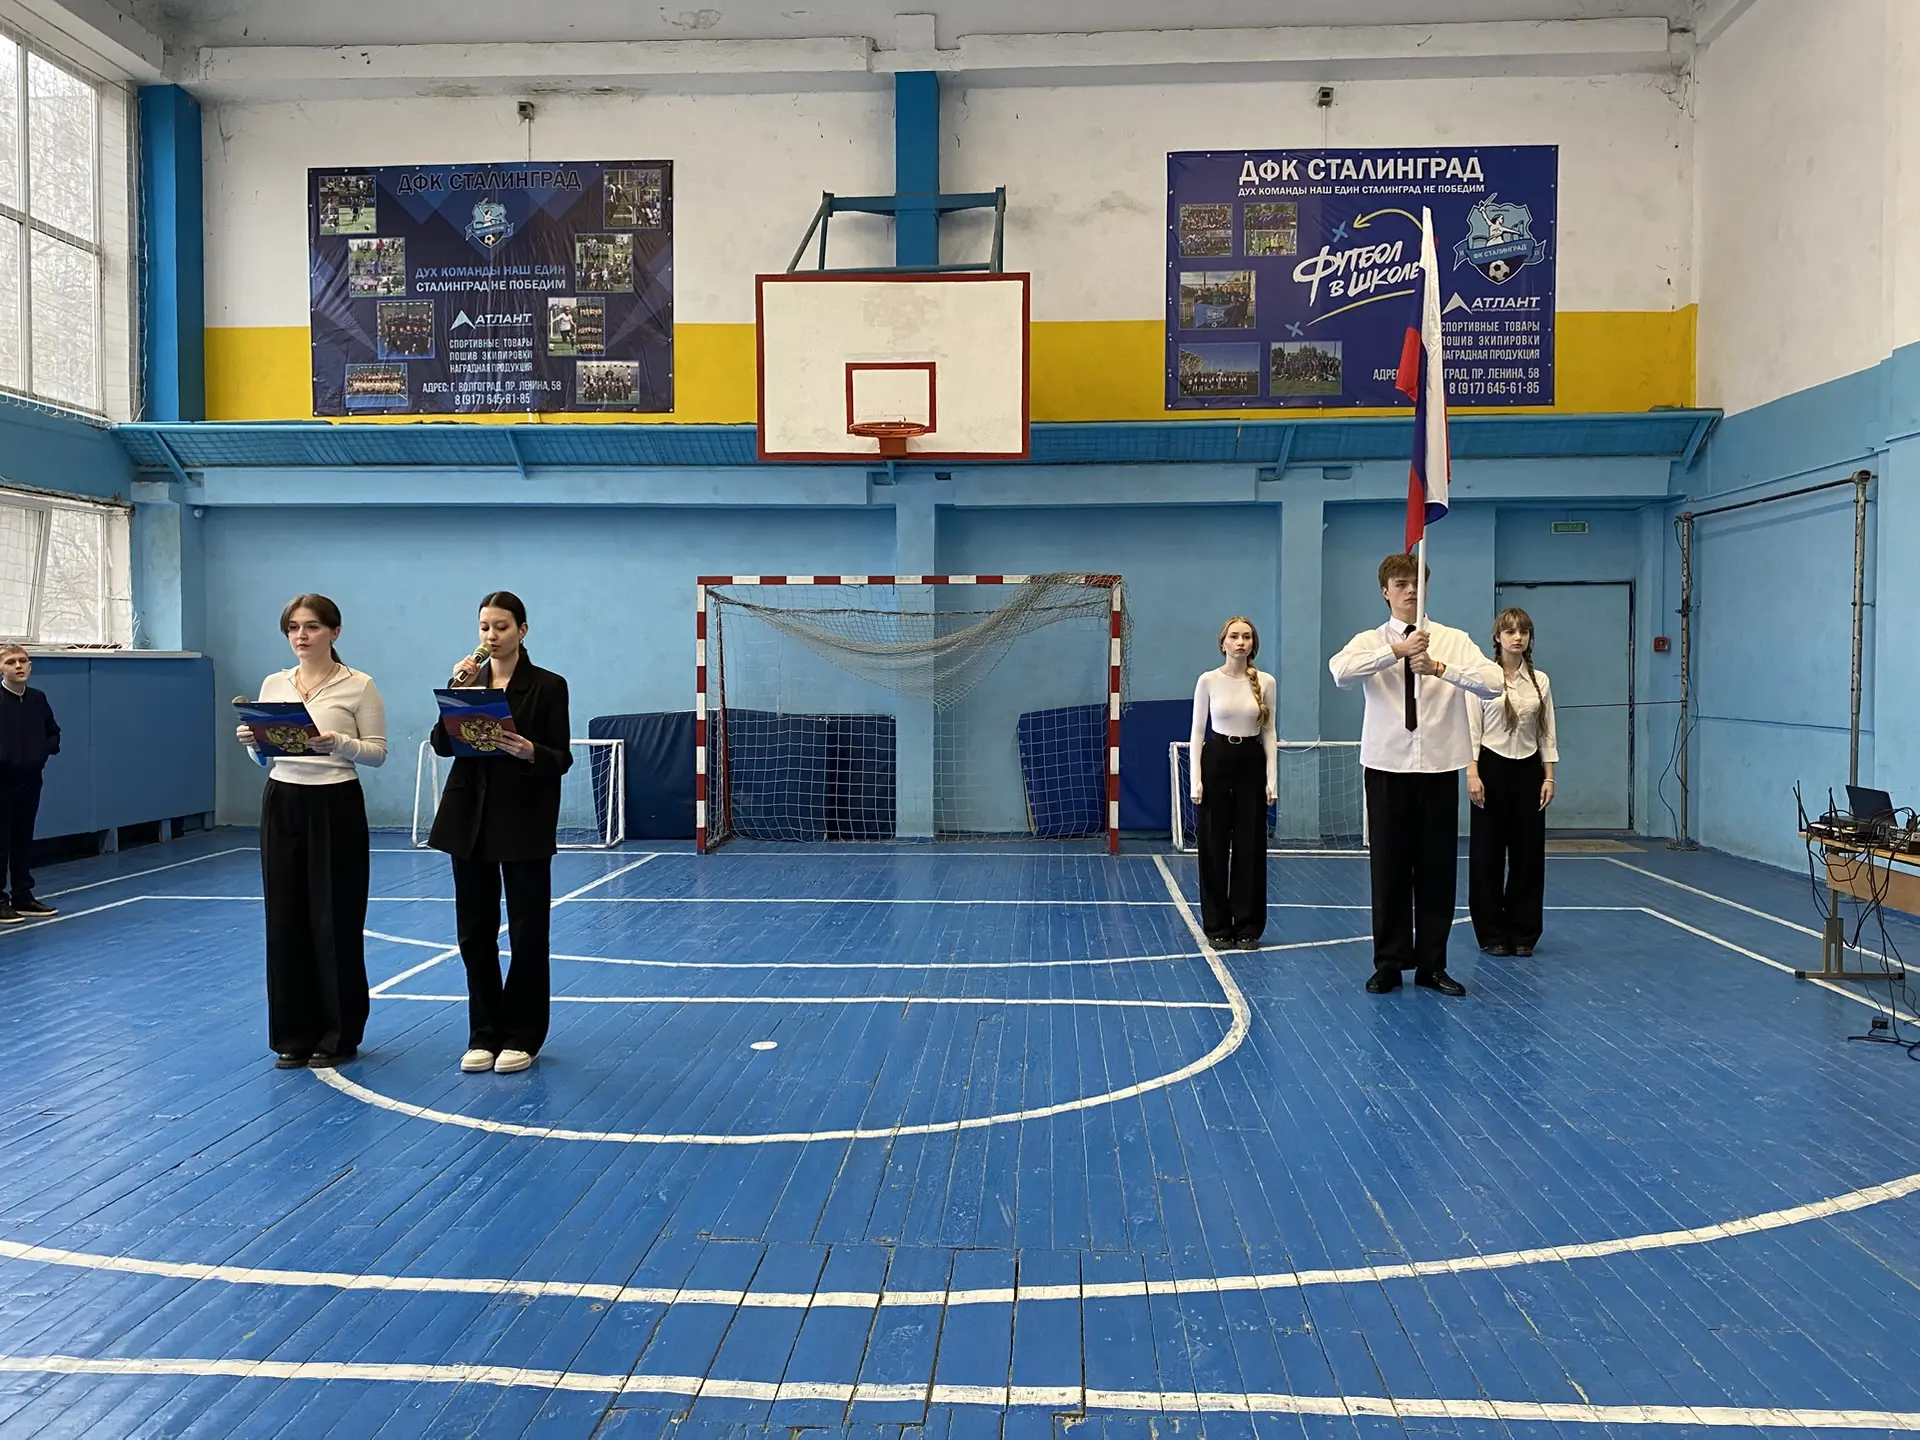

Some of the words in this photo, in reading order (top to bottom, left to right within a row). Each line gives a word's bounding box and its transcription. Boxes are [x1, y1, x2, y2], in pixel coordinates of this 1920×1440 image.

[1239, 159, 1299, 185] ДФК
[1308, 157, 1484, 182] СТАЛИНГРАД
[398, 174, 442, 194] ДФК
[450, 171, 582, 190] СТАЛИНГРАД
[1238, 187, 1256, 197] ДУХ
[1259, 186, 1307, 196] КОМАНДЫ
[1310, 186, 1332, 195] НАШ
[1334, 186, 1360, 195] ЕДИН
[1362, 185, 1421, 195] СТАЛИНГРАД
[1424, 185, 1436, 194] НЕ
[1438, 184, 1484, 194] ПОБЕДИМ
[415, 268, 438, 279] ДУХ
[441, 266, 500, 278] КОМАНДЫ
[504, 265, 531, 276] НАШ
[535, 265, 566, 276] ЕДИН
[1293, 240, 1403, 307] ФУТБОЛ
[416, 281, 490, 292] СТАЛИНГРАД
[492, 280, 506, 290] НЕ
[510, 280, 566, 290] ПОБЕДИМ
[1347, 262, 1420, 298] ШКОЛЕ
[1472, 297, 1540, 308] АТЛАНТ
[475, 314, 532, 324] АТЛАНТ
[1441, 322, 1499, 332] СПОРТИВНЫЕ
[1505, 322, 1540, 331] ТОВАРЫ
[450, 338, 500, 349] СПОРТИВНЫЕ
[504, 338, 532, 348] ТОВАРЫ
[1478, 336, 1540, 346] ЭКИПИРОВКИ
[450, 352, 478, 360] ПОШИВ
[482, 350, 532, 360] ЭКИПИРОВКИ
[1490, 350, 1540, 360] ПРОДУКЦИЯ
[450, 363, 490, 374] НАГРАДНАЯ
[492, 362, 532, 372] ПРОДУКЦИЯ
[1372, 368, 1397, 380] АДРЕ
[1472, 368, 1486, 380] ПР.
[1488, 368, 1526, 380] ЛЕНИНА,
[1528, 368, 1540, 378] 58
[422, 382, 449, 393] АДРЕС:
[505, 382, 518, 391] ПР.
[520, 381, 550, 392] ЛЕНИНА,
[552, 380, 562, 390] 58
[1449, 382, 1456, 394] 8
[1458, 382, 1484, 394] (917)
[1487, 382, 1540, 394] 645-61-85
[454, 394, 460, 406] 8
[462, 394, 484, 405] (917)
[486, 393, 530, 404] 645-61-85
